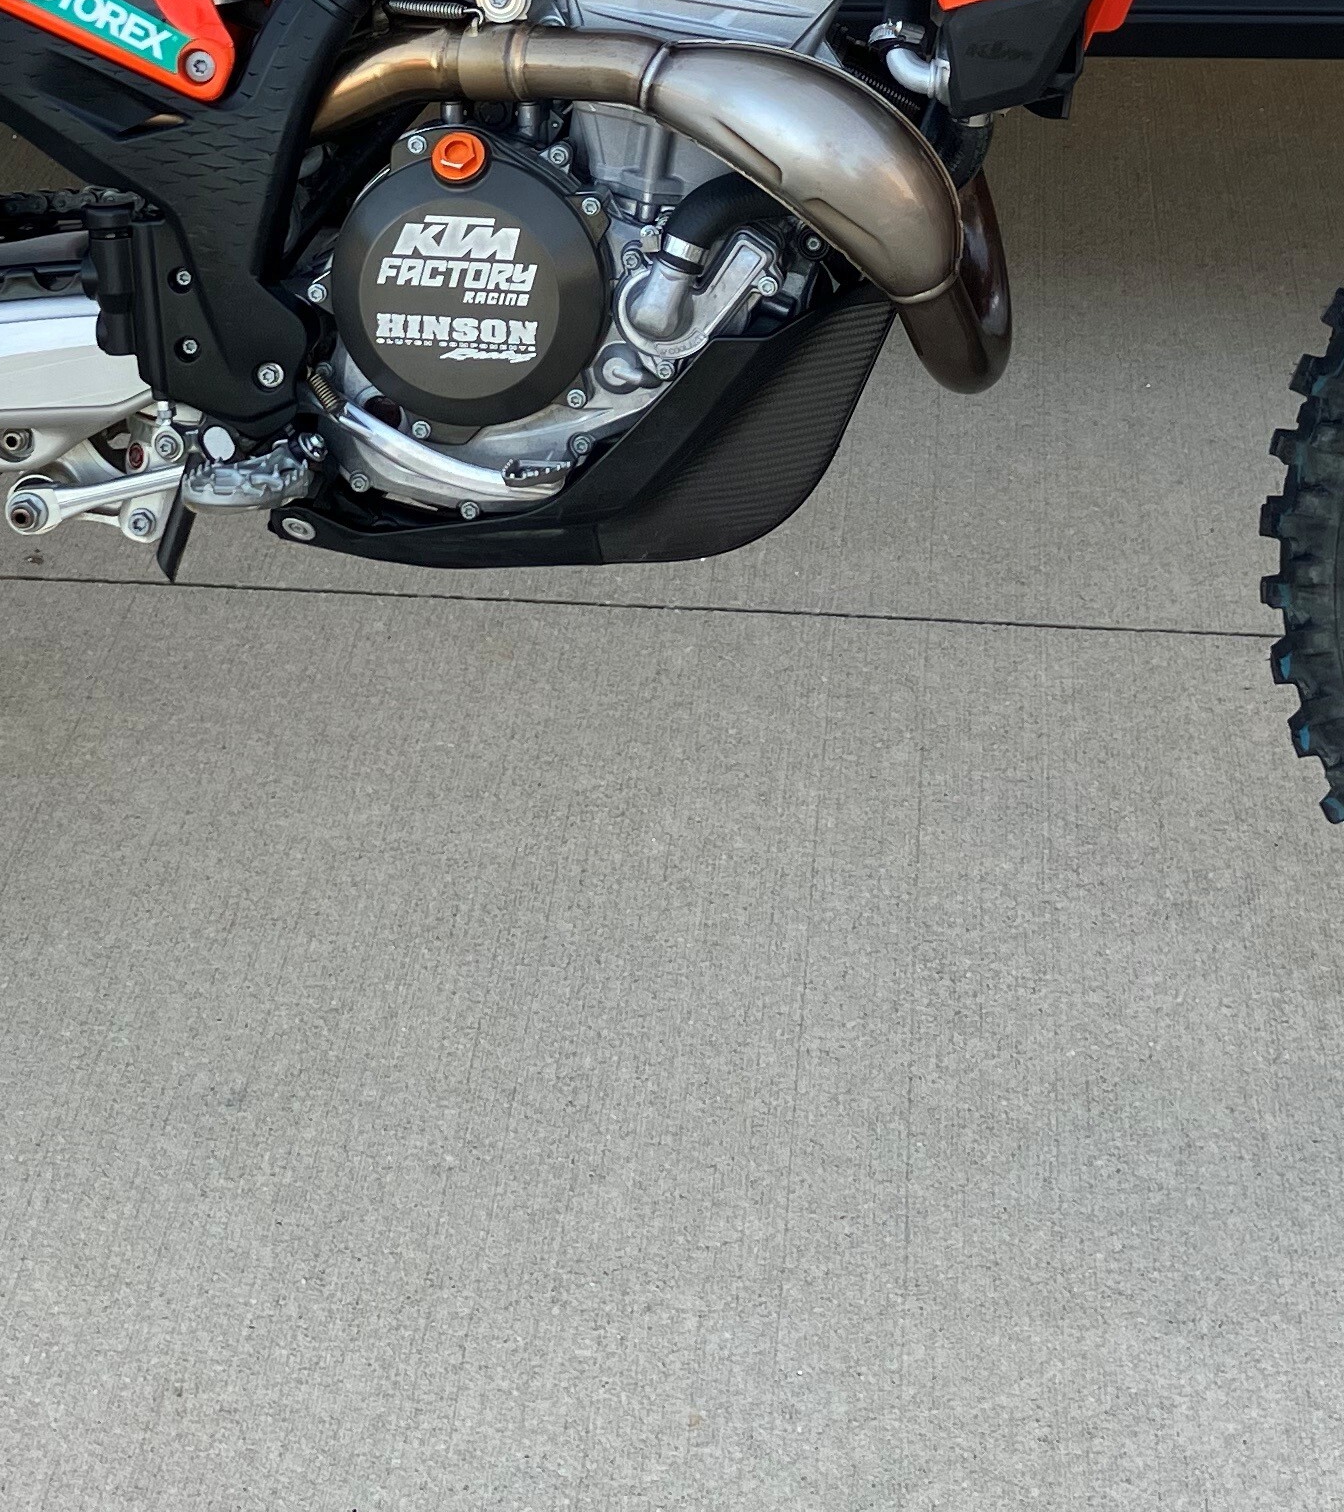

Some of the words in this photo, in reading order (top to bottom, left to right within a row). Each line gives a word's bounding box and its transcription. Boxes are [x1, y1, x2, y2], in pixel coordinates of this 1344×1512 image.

[393, 215, 520, 260] KTM
[377, 257, 537, 291] FACTORY
[463, 291, 530, 306] RACING
[376, 313, 538, 345] HINSON
